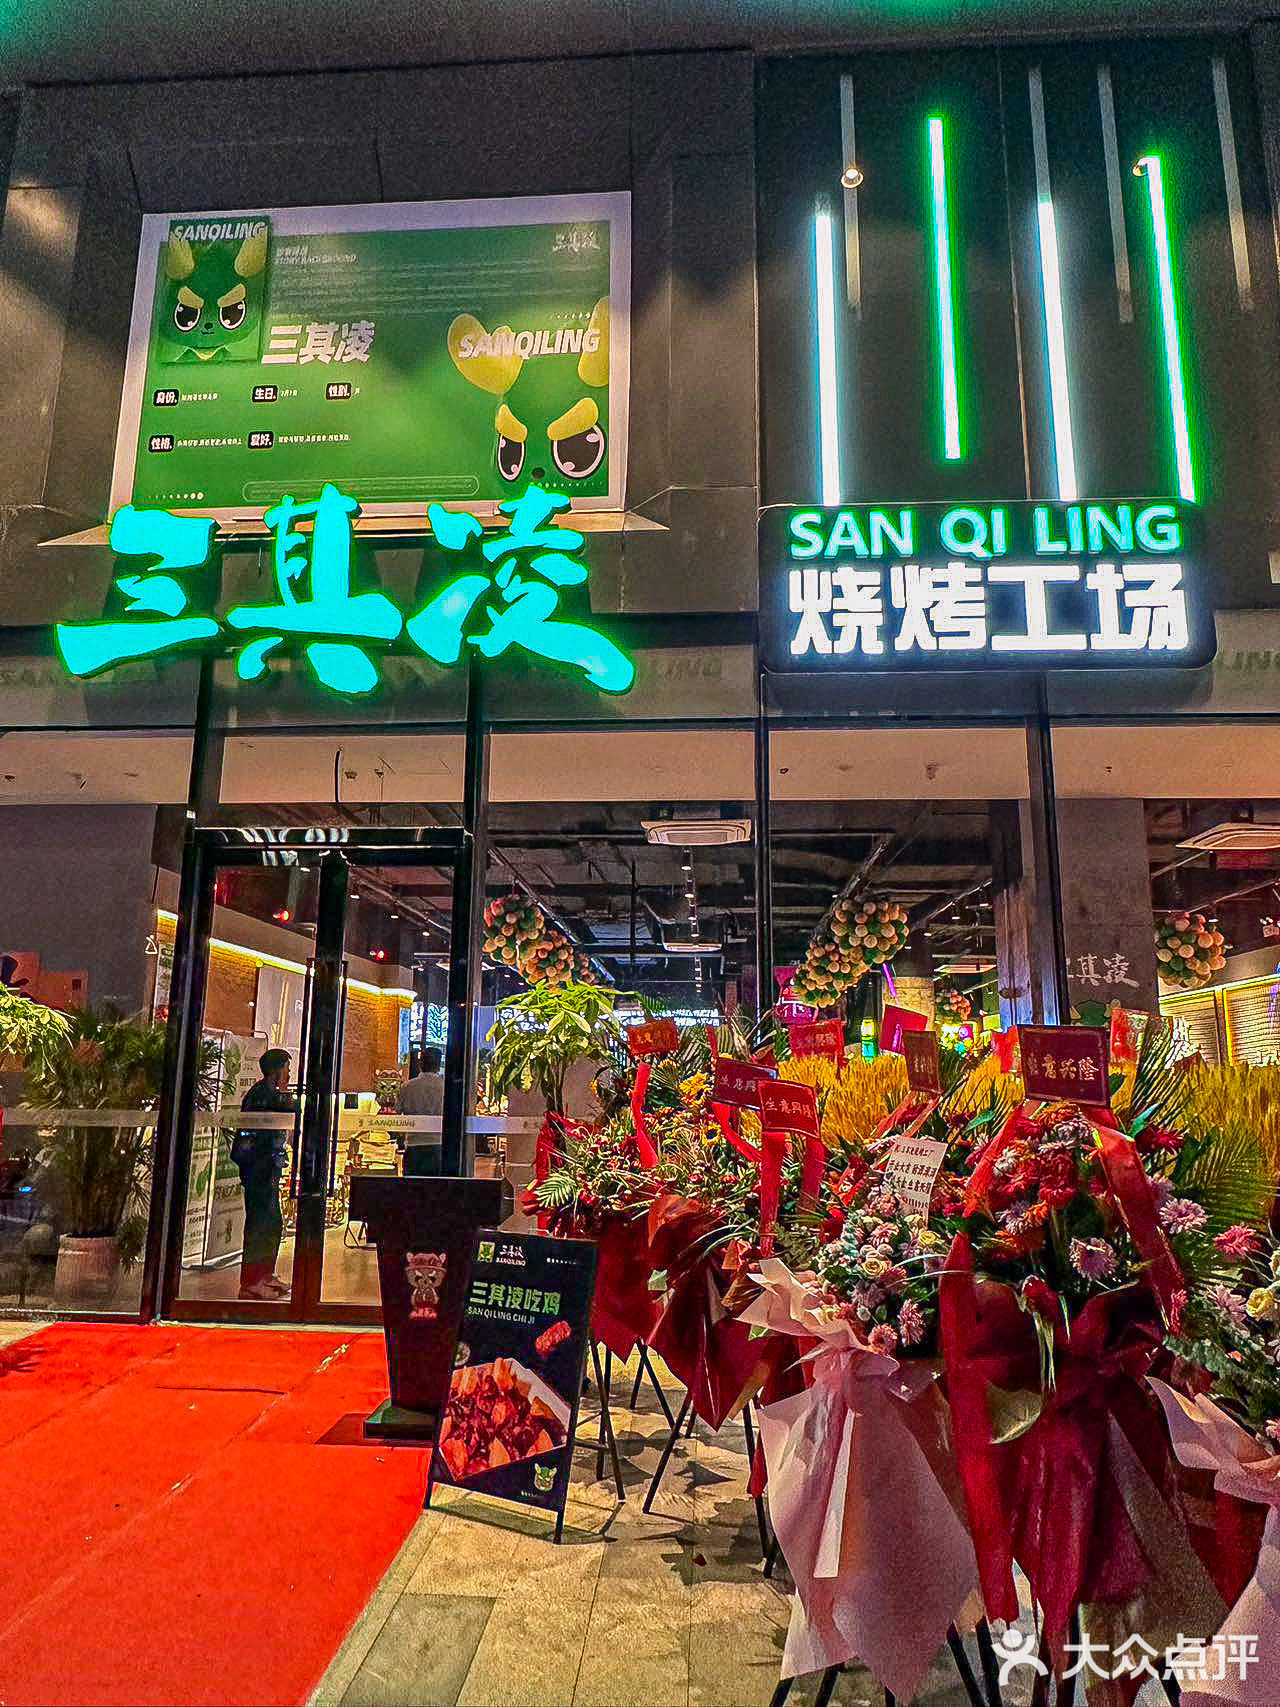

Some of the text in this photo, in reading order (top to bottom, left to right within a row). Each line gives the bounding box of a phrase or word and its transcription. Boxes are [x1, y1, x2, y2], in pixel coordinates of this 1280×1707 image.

[174, 222, 266, 243] SANQILING
[261, 320, 375, 365] 三其凌
[458, 328, 601, 360] SANQILING
[789, 504, 1182, 558] SAN QI LING
[56, 483, 635, 694] 三其凌
[788, 562, 1189, 655] 烧烤工场
[1066, 952, 1140, 988] 其凌
[469, 1281, 561, 1315] 三其凌吃鸡
